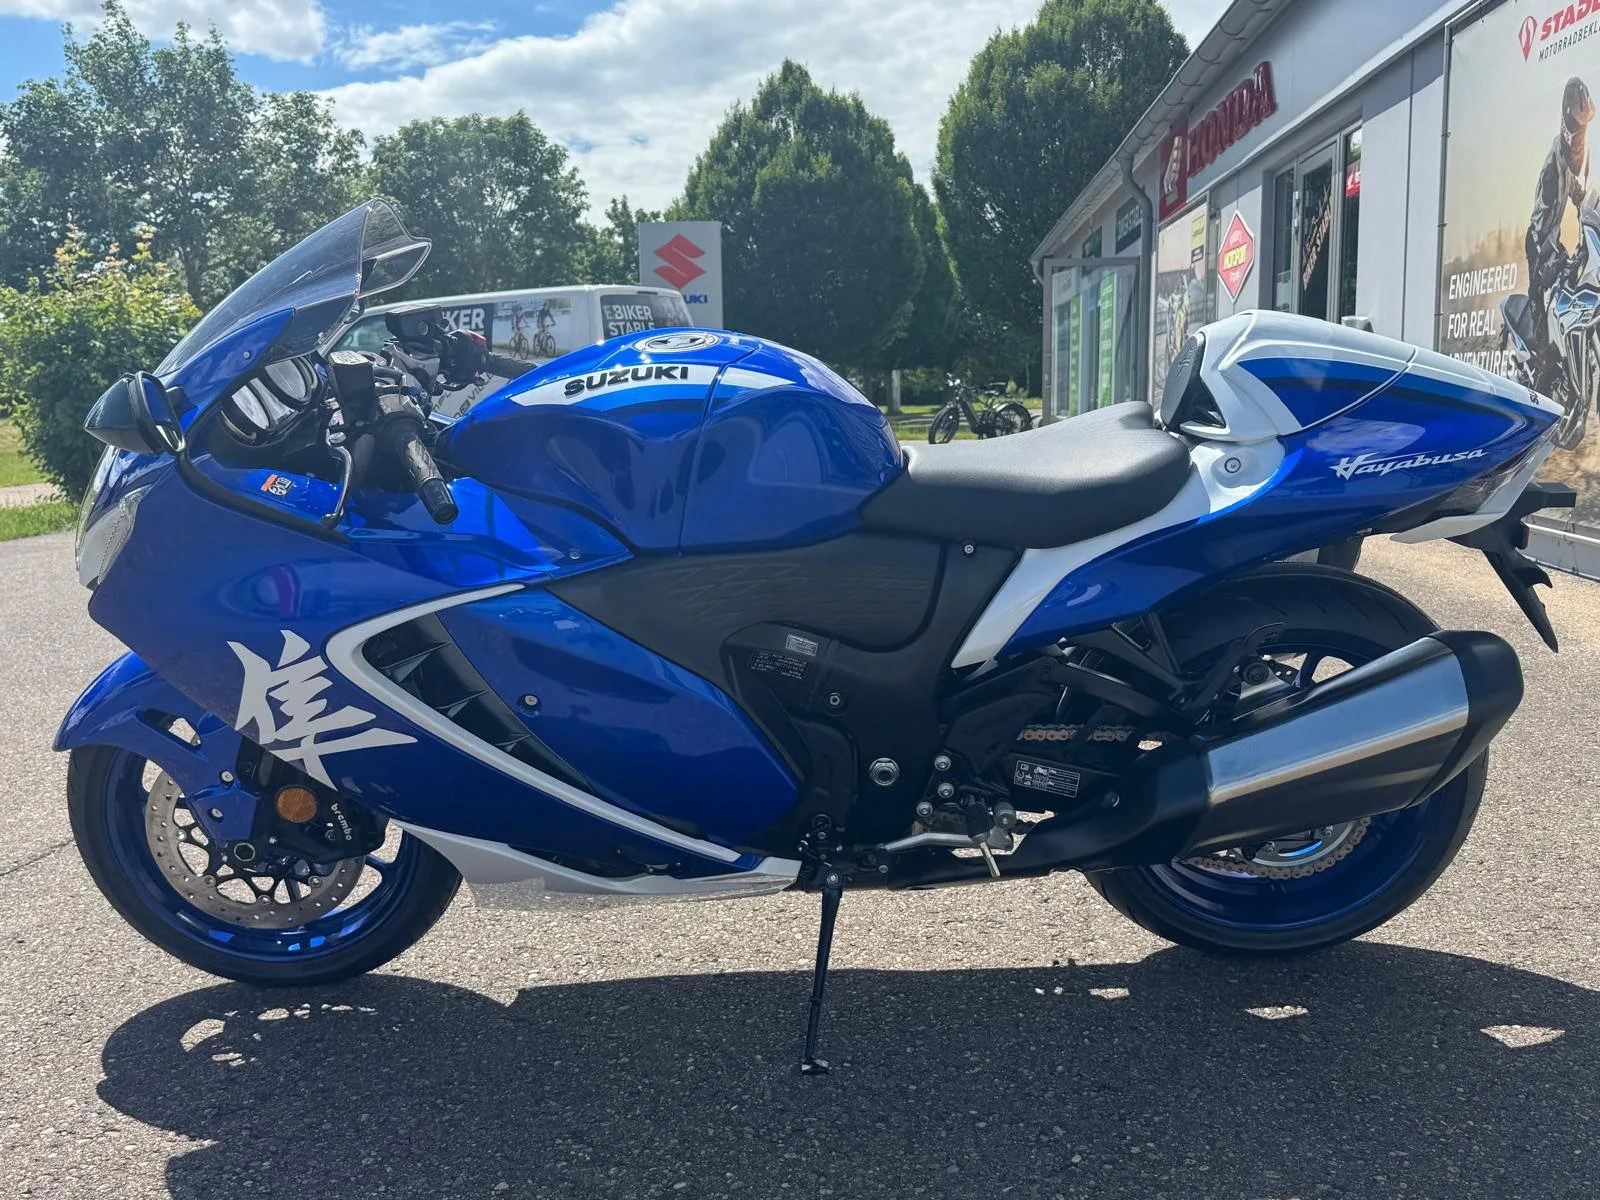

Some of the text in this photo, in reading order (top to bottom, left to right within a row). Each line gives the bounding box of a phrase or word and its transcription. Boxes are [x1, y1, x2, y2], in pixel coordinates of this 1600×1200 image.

[1538, 20, 1600, 62] MOTORRADBEKL
[1186, 61, 1277, 177] HONDA
[1448, 262, 1518, 300] ENGINEERED
[442, 308, 485, 331] KER
[1447, 309, 1497, 339] FOR REAL
[564, 366, 690, 397] SUZUKI
[1329, 449, 1489, 480] Hayabusa
[227, 630, 418, 792] 隼
[331, 803, 352, 841] brembo
